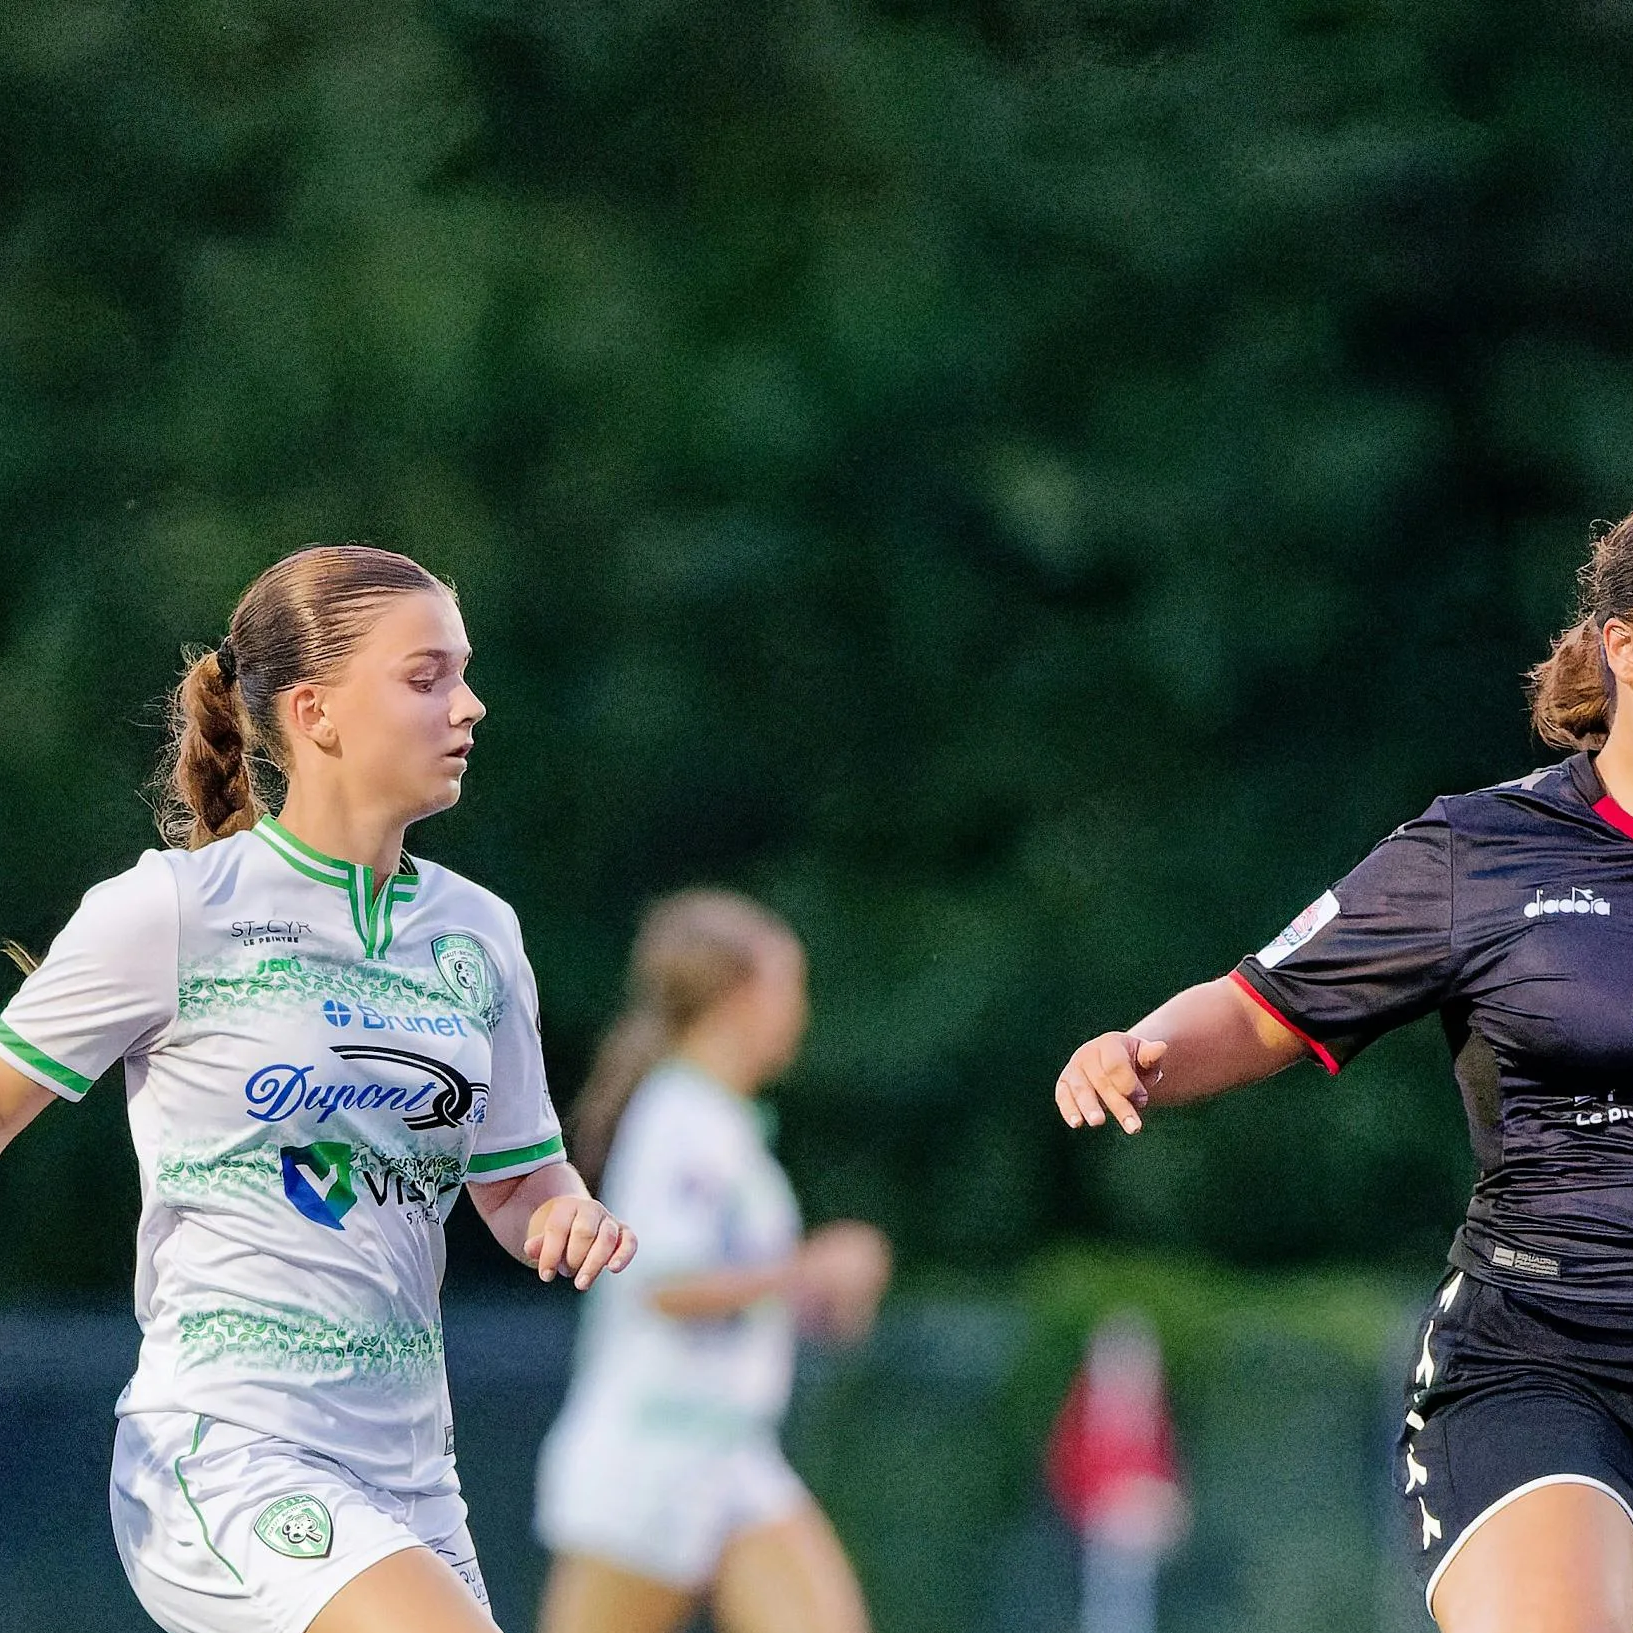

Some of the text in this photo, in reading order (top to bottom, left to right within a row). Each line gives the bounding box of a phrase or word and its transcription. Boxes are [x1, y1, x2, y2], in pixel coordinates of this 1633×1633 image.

[1523, 886, 1611, 919] diadora
[230, 919, 313, 938] ST-CYR
[356, 1003, 469, 1038] Brunet
[245, 1063, 437, 1124] Dupont
[1575, 1112, 1604, 1126] Le
